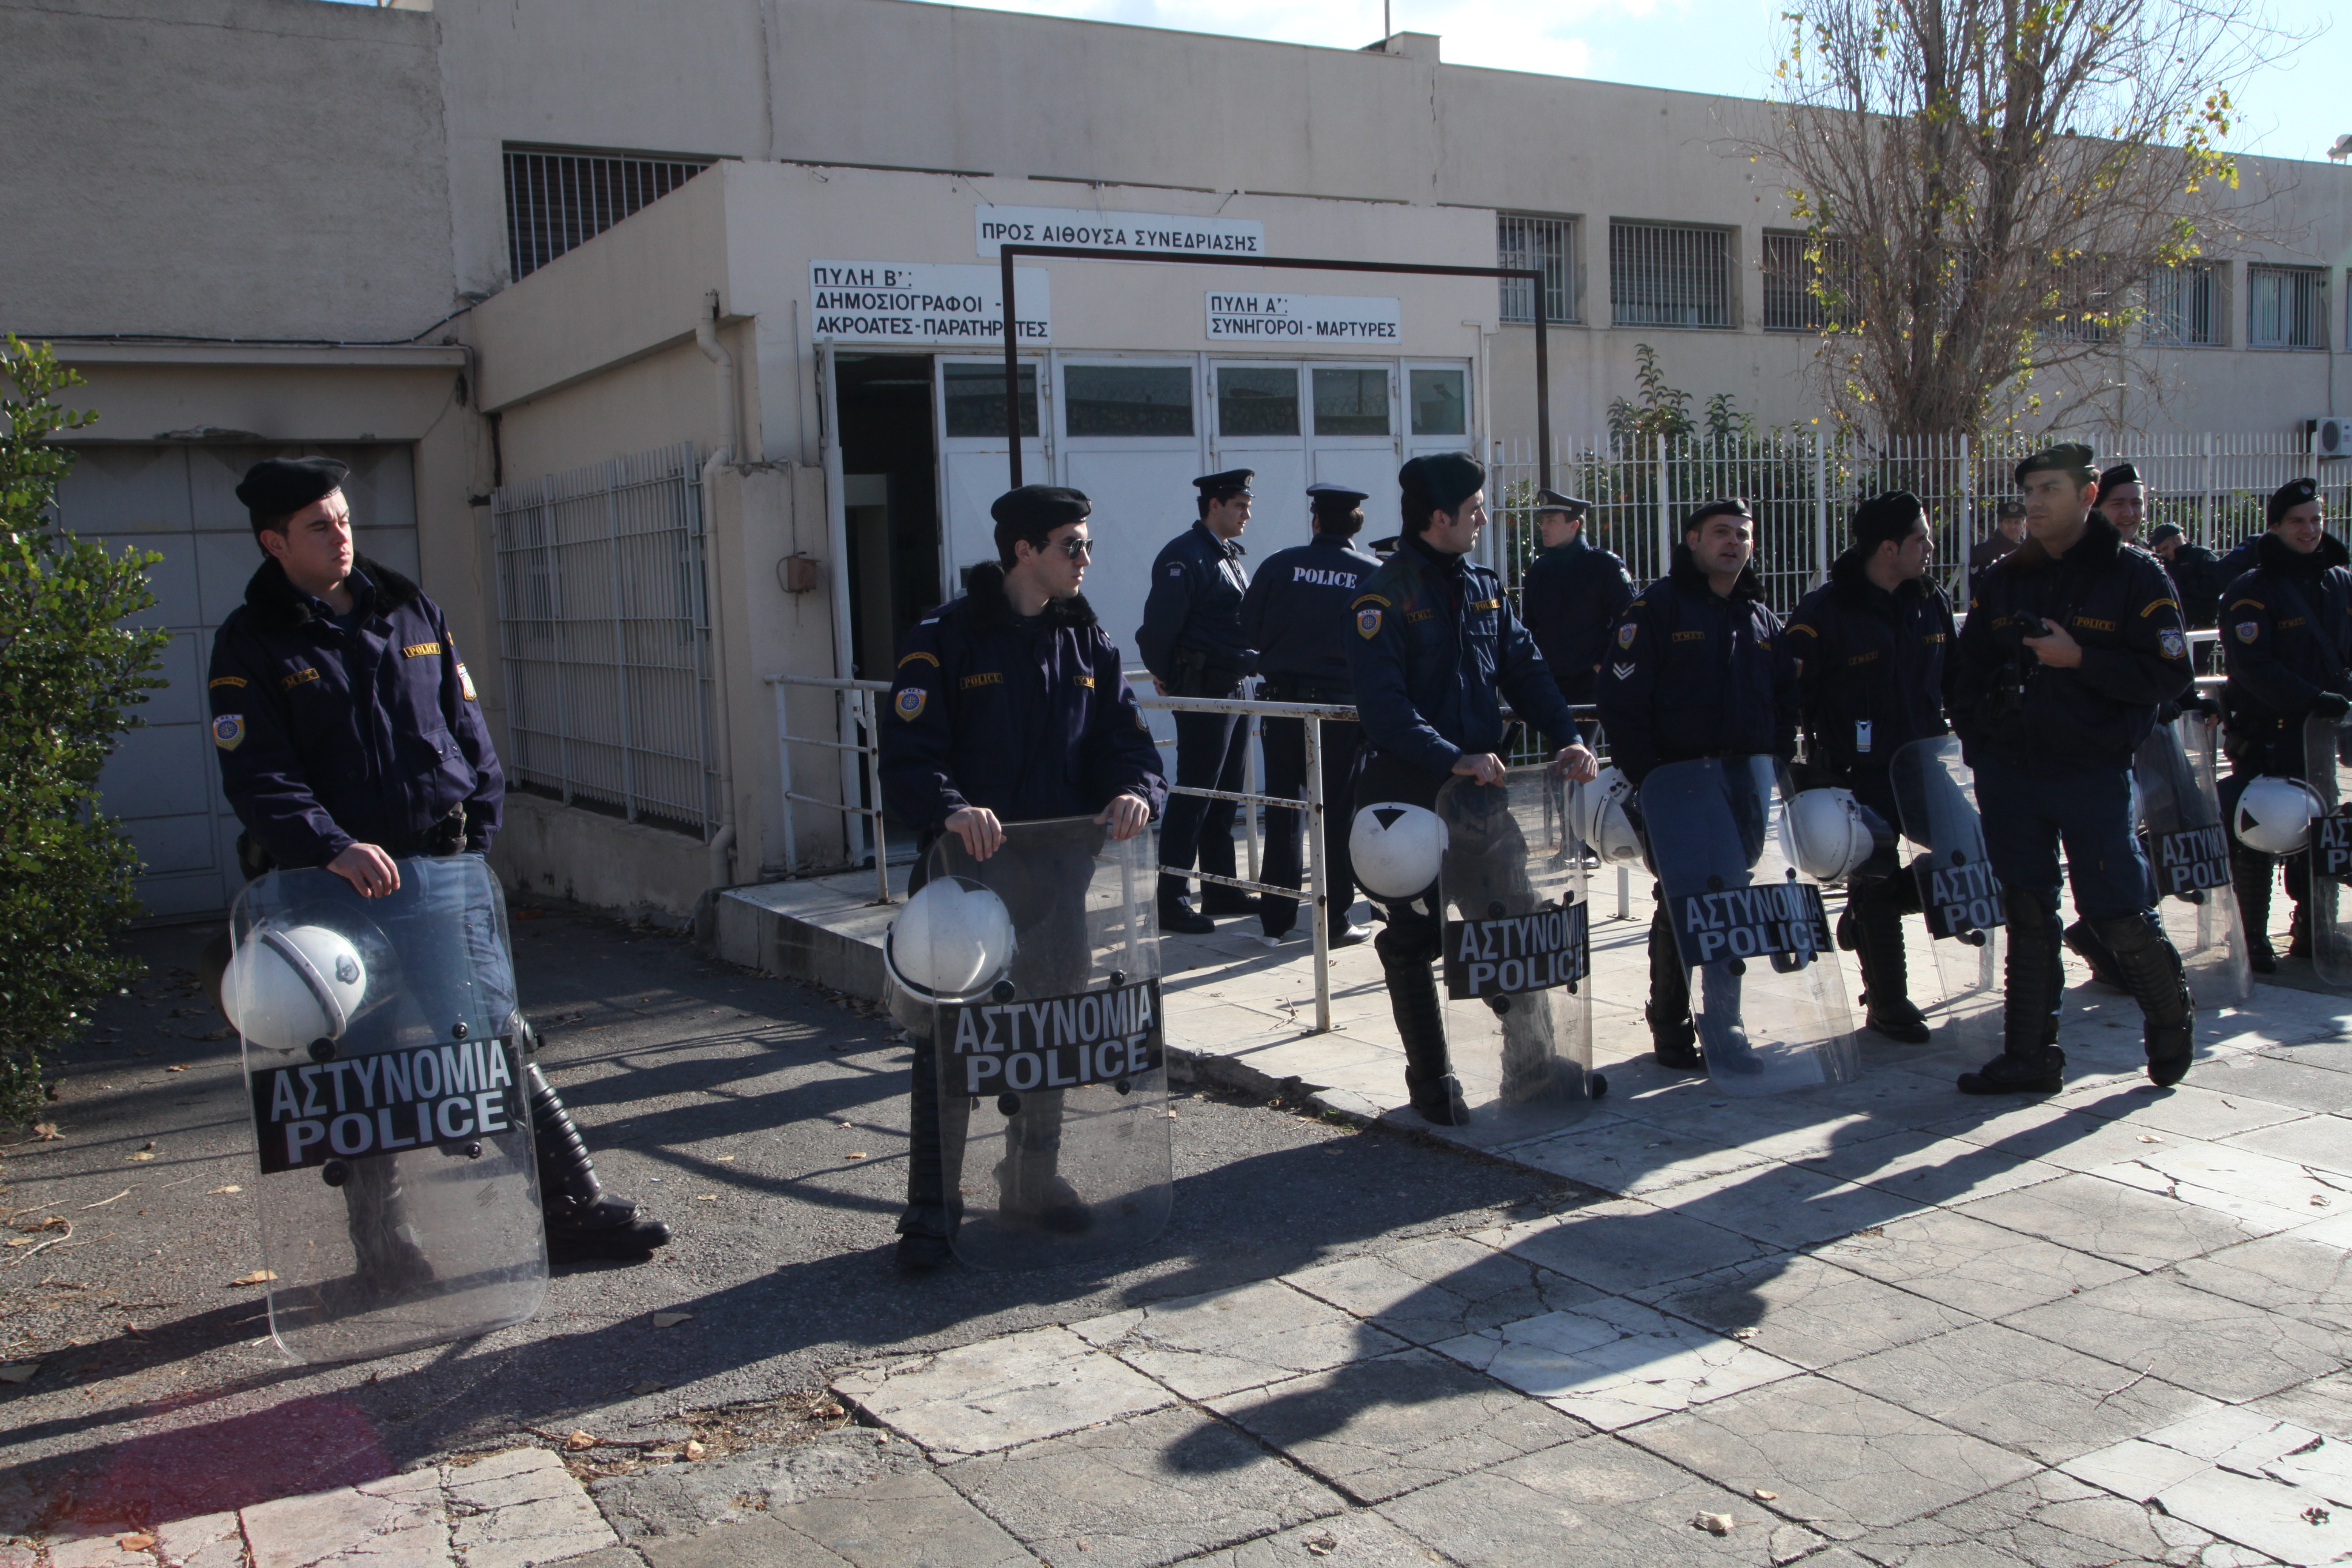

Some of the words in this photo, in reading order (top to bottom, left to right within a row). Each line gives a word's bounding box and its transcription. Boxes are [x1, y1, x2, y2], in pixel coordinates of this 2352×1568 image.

[982, 222, 1035, 241] ΠΡΟΣ
[1042, 225, 1127, 246] ΑΙΘΟΥΣΑ
[1134, 230, 1257, 252] ΣΥΝΕΔΡΙΑΣΗΣ
[814, 267, 874, 286] ΠΥΛΗ
[816, 292, 982, 313] ΔΗΜΟΣΙΟΓΡΑΦΟΙ
[1211, 296, 1257, 312] ΠΥΛΗ
[816, 316, 1048, 338] ΑΚΡΟΑΤΕΣ-ΠΑΡΑΤΗΡΤΕΣ
[1212, 318, 1303, 335] ΣΥΝΗΓΟΡΟΙ
[1316, 321, 1396, 337] ΜΑΡΤΥΡΕΣ
[1292, 566, 1358, 589] POLICE
[2077, 617, 2112, 630] POLICE
[408, 644, 438, 655] POLICE
[964, 673, 1000, 688] POLICE
[1687, 887, 1822, 933] ΑΣΤΥΝΟΜΙΑ
[1943, 896, 2006, 933] POL
[1458, 905, 1586, 962] ΑΣΤΥΝΟΜΙΑ
[1698, 922, 1826, 961] POLICE
[1468, 944, 1585, 995] POLICE
[953, 985, 1154, 1054] ΑΣΤΥΝΟΜΙΑ
[966, 1032, 1148, 1093] POLICE
[271, 1039, 512, 1122] ΑΣΤΥΝΟΜΙΑ
[285, 1091, 508, 1164] POLICE
